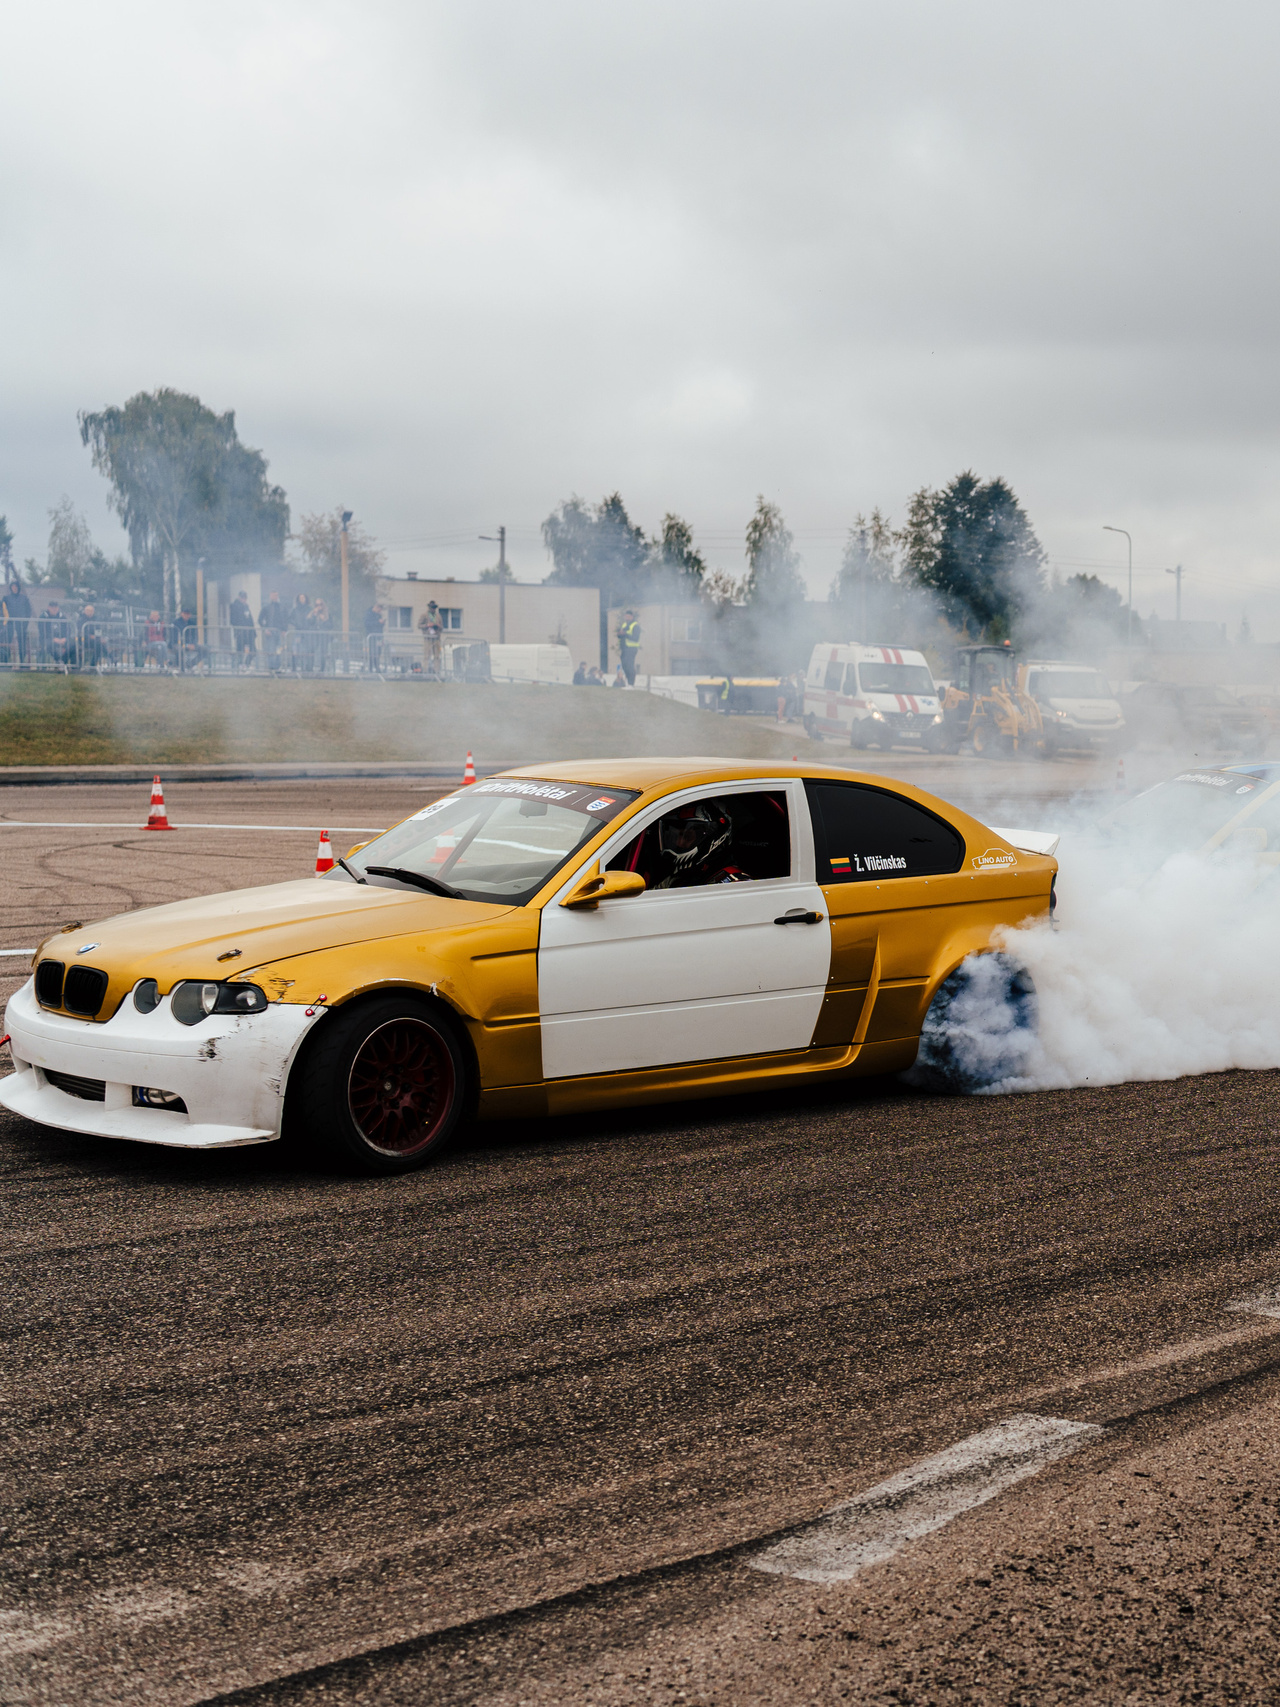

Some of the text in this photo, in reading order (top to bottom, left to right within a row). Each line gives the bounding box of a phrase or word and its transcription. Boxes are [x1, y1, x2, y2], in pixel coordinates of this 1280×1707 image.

[853, 853, 906, 872] Ž. Vilčinskas
[978, 855, 1014, 865] LINO AUTO
